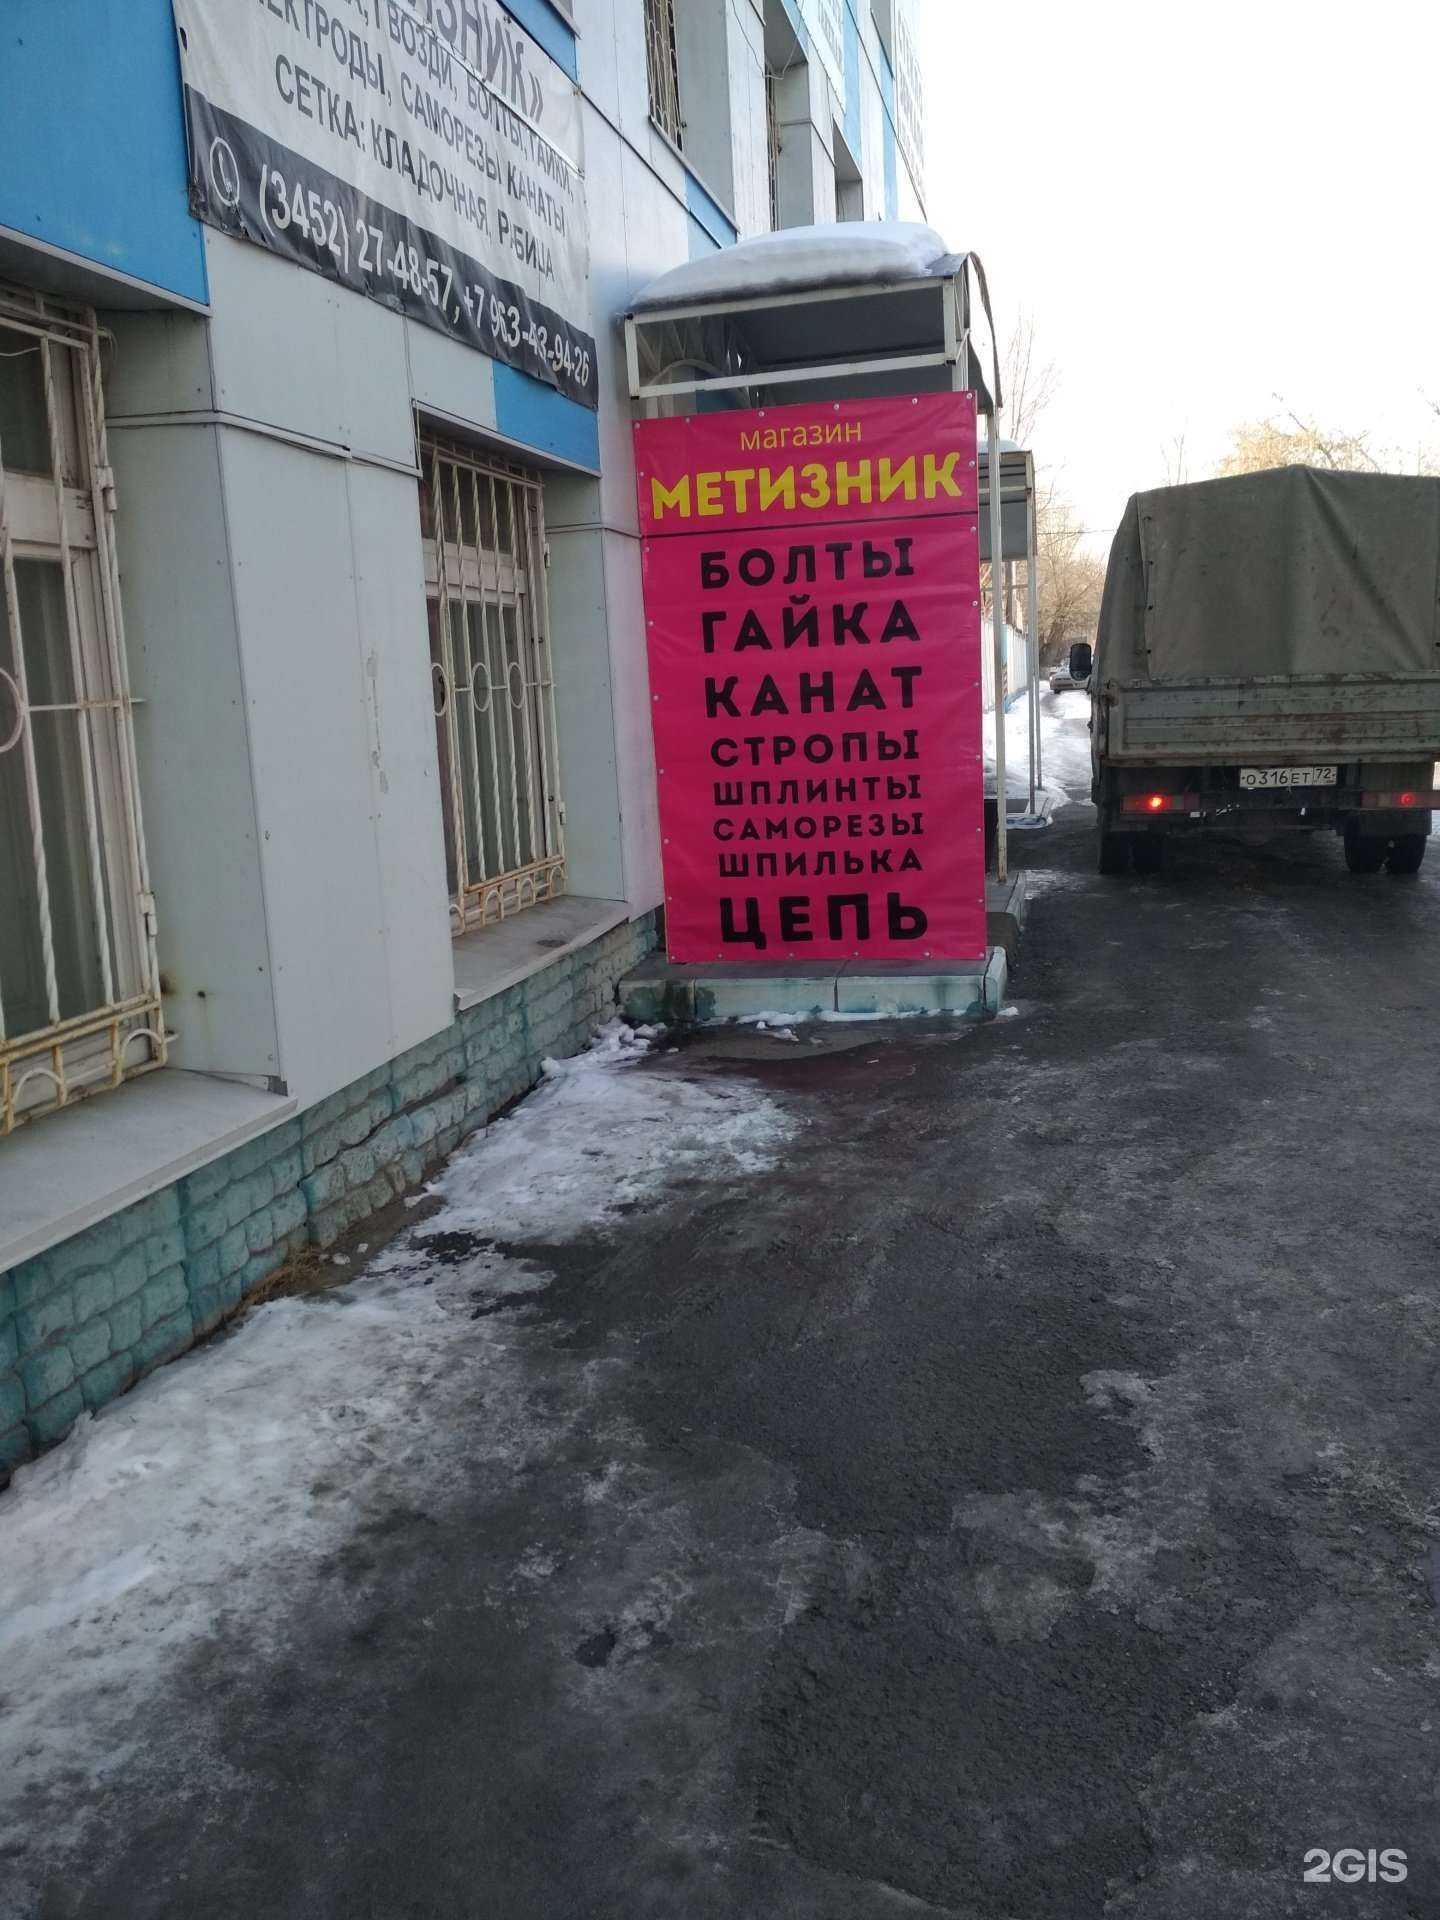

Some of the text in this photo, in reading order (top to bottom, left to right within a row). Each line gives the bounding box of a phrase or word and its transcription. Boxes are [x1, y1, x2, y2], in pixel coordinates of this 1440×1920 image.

[410, 0, 544, 124] ЗНИК»
[275, 54, 366, 152] СЕТКА:
[497, 208, 555, 282] РБИЦА
[507, 160, 566, 238] КАНАТЫ
[260, 164, 349, 273] (3452)
[356, 219, 460, 323] 27-48-57,
[740, 421, 862, 451] магазин
[651, 452, 963, 519] МЕТИЗНИК
[701, 538, 914, 590] БОЛТЫ
[702, 594, 921, 653] ГАЙКА
[705, 666, 922, 718] КАНАТ
[711, 729, 919, 767] СТРОПЫ
[713, 774, 921, 805] ШПЛИНТЫ
[713, 812, 923, 841] САМОРЕЗЫ
[719, 848, 922, 877] ШПИЛЬКА
[720, 892, 928, 950] ЦЕПЬ
